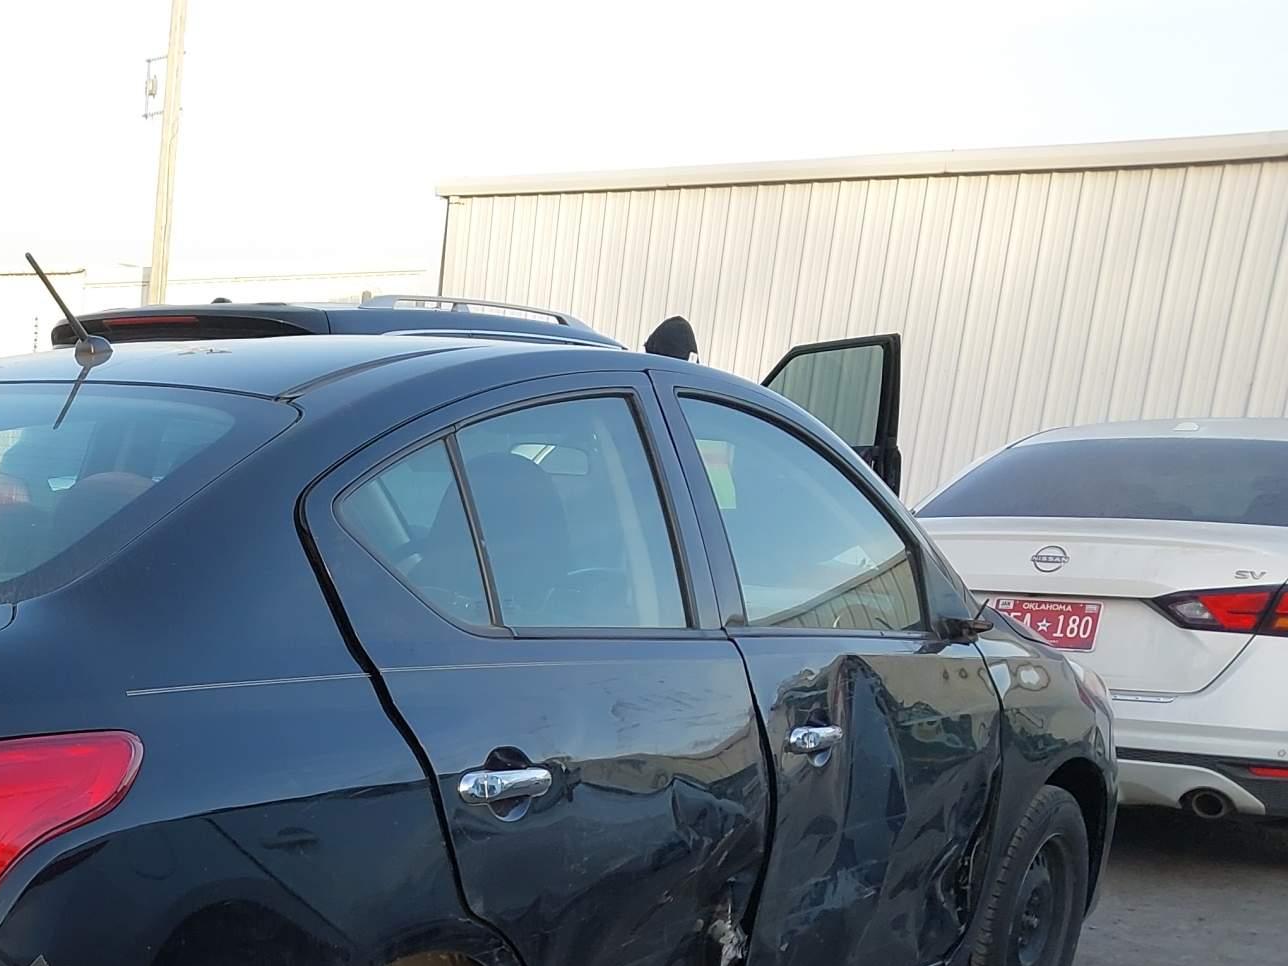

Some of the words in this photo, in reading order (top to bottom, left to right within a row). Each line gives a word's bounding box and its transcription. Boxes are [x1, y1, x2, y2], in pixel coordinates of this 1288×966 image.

[1031, 555, 1069, 563] NISSAN
[1234, 570, 1266, 580] SV
[1022, 602, 1073, 612] OKLAHOMA
